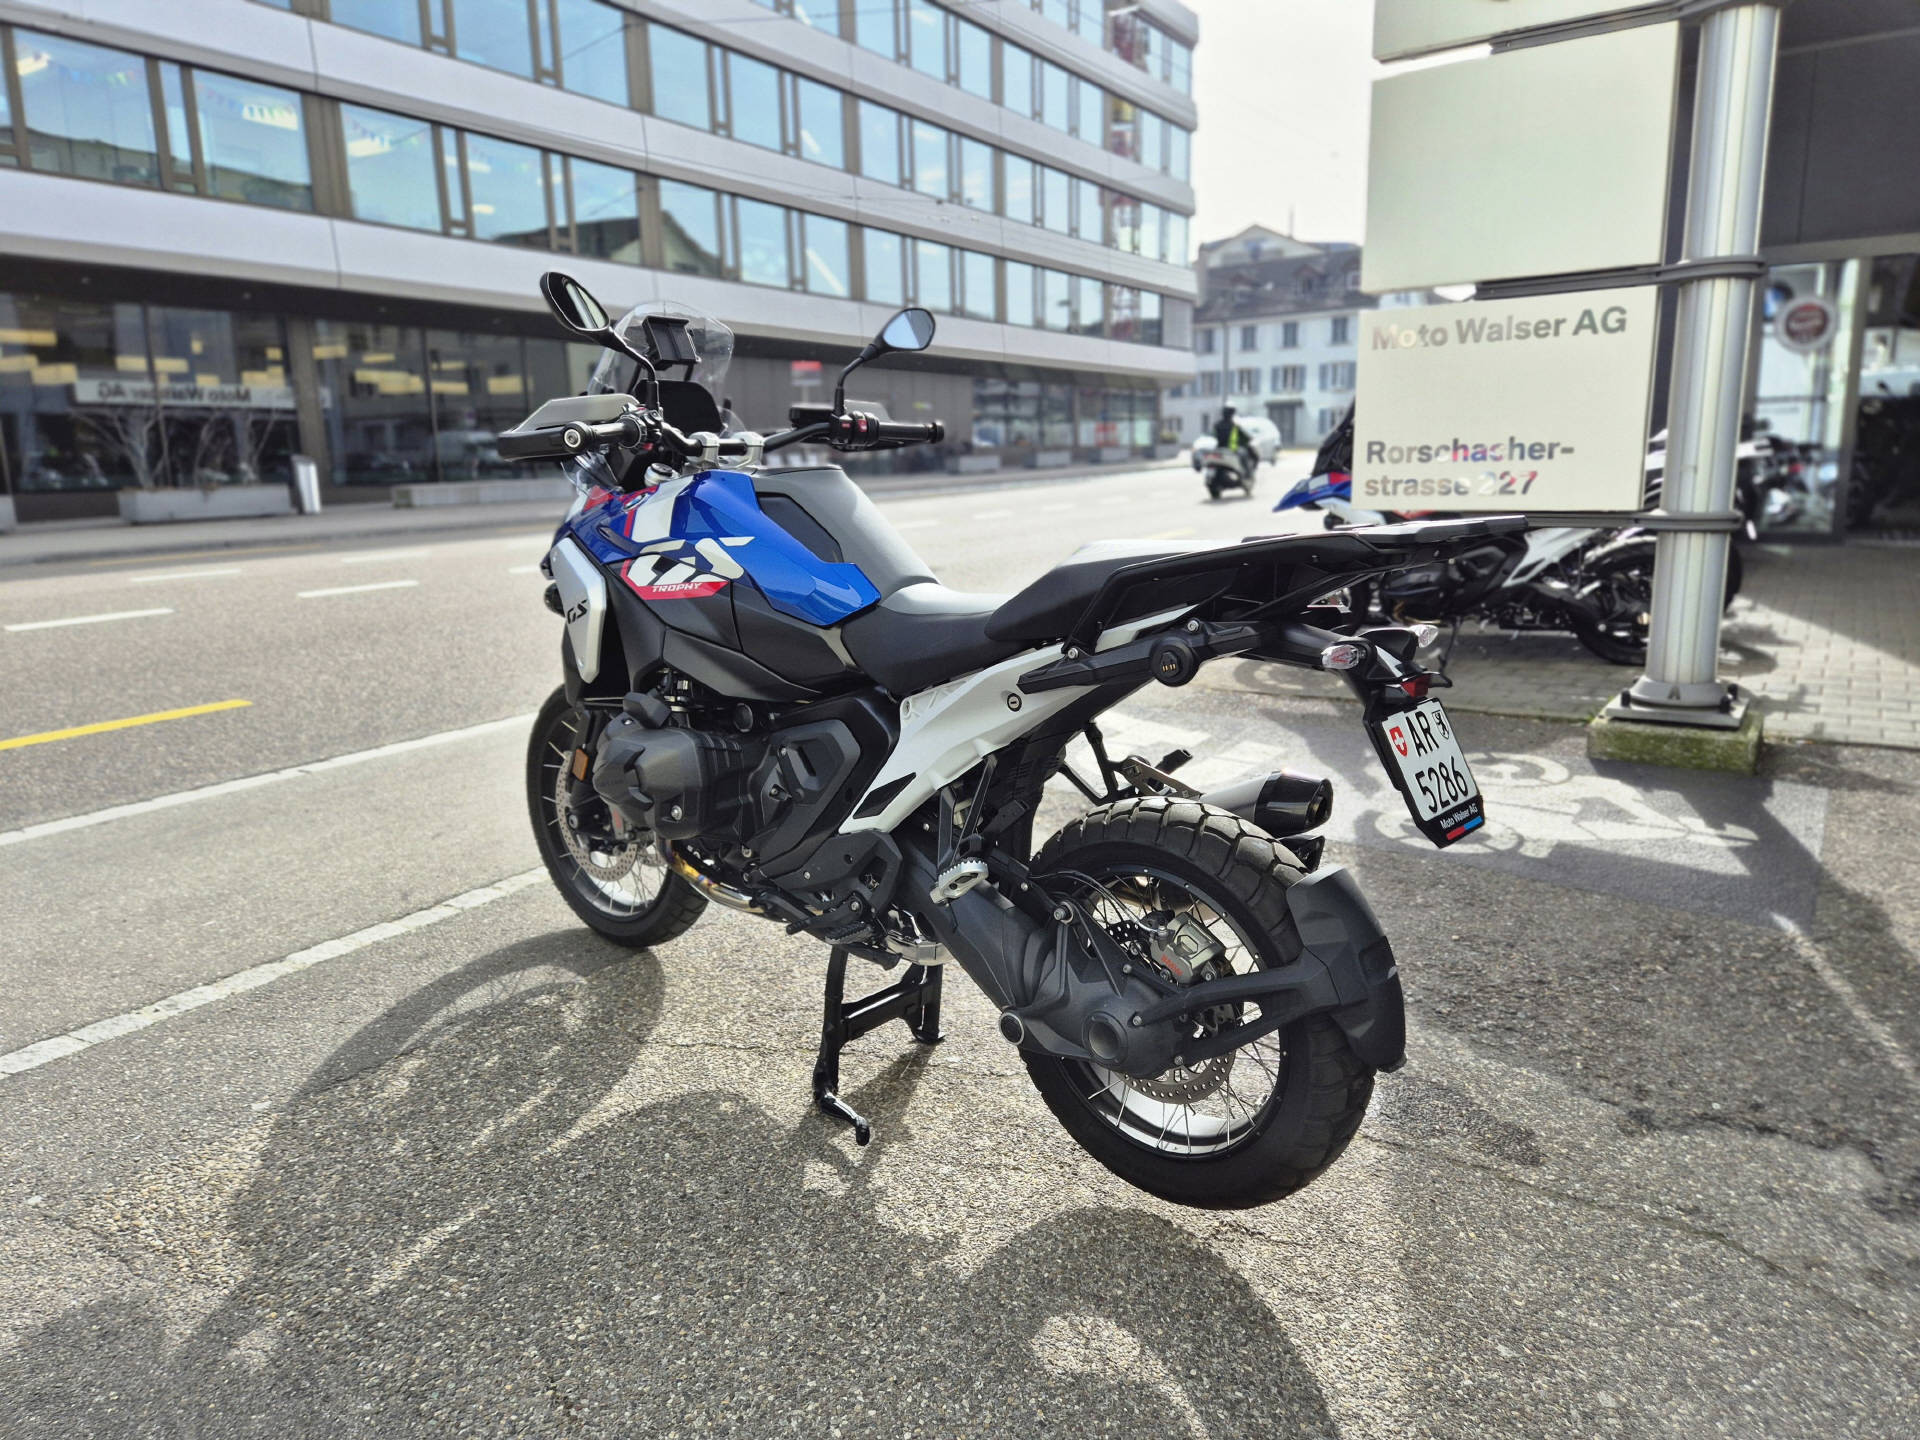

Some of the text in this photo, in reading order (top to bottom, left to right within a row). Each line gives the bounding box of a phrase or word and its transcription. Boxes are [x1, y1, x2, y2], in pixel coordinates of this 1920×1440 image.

[1371, 306, 1628, 351] Moto Walser AG
[1365, 436, 1575, 464] Rorschacher-
[1364, 470, 1538, 497] strasse 227
[651, 582, 704, 593] TROPHY
[566, 599, 589, 625] GS
[1405, 710, 1440, 757] AR
[1414, 756, 1469, 814] 5286
[1440, 817, 1455, 829] Moto
